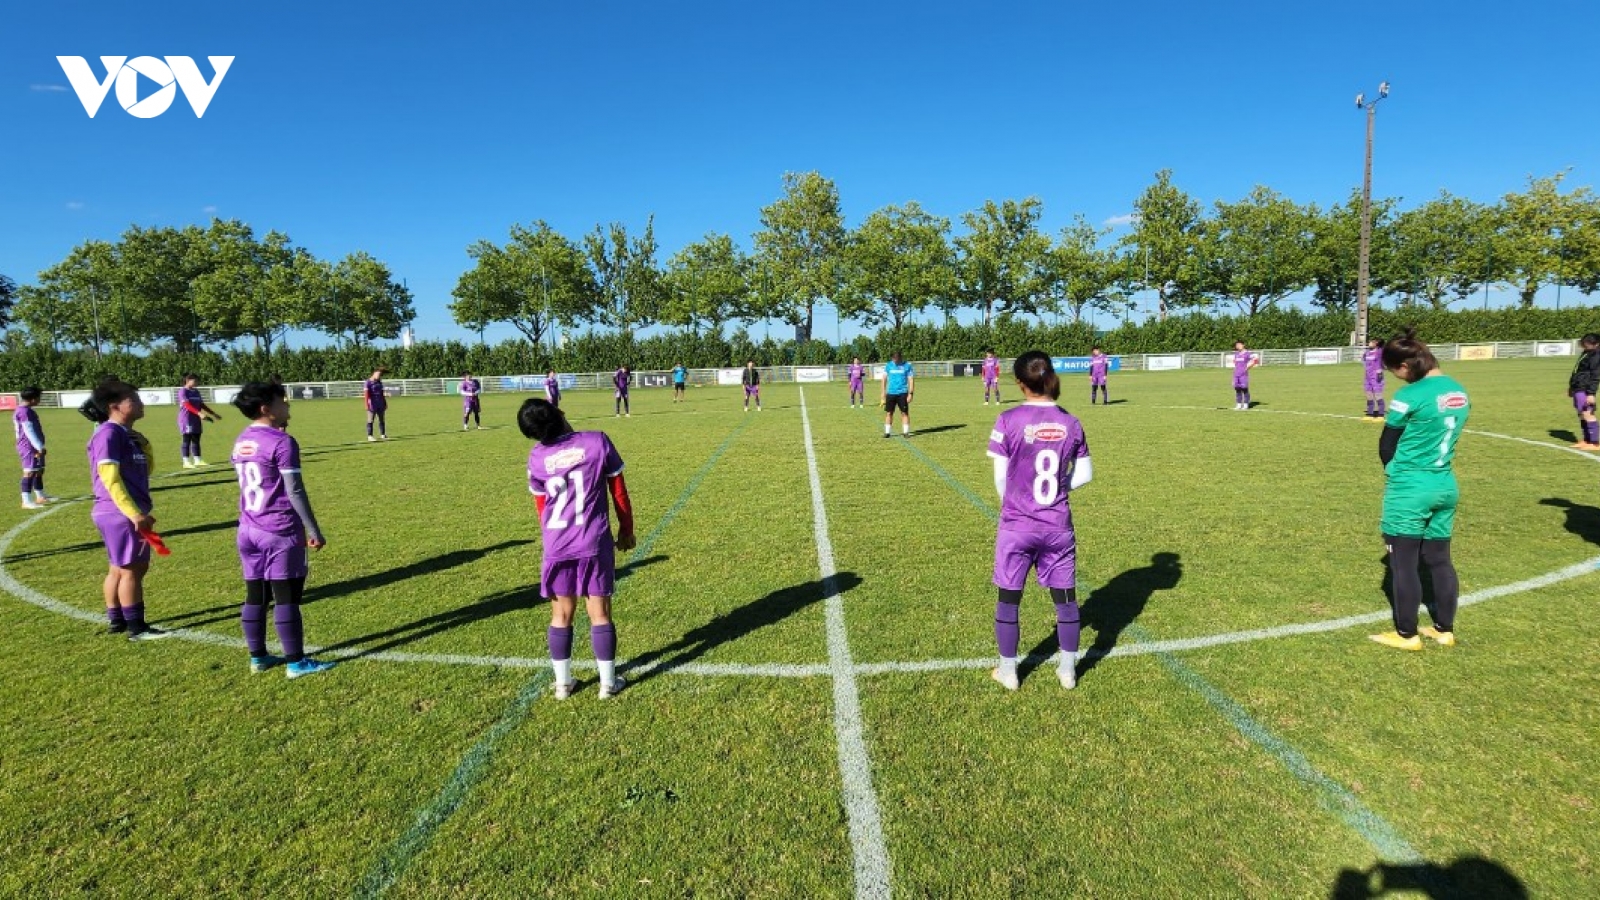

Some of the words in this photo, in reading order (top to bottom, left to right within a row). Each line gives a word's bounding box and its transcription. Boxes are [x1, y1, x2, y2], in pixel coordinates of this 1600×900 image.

[1435, 416, 1456, 467] 1
[546, 470, 584, 529] 21
[1033, 449, 1059, 505] 8
